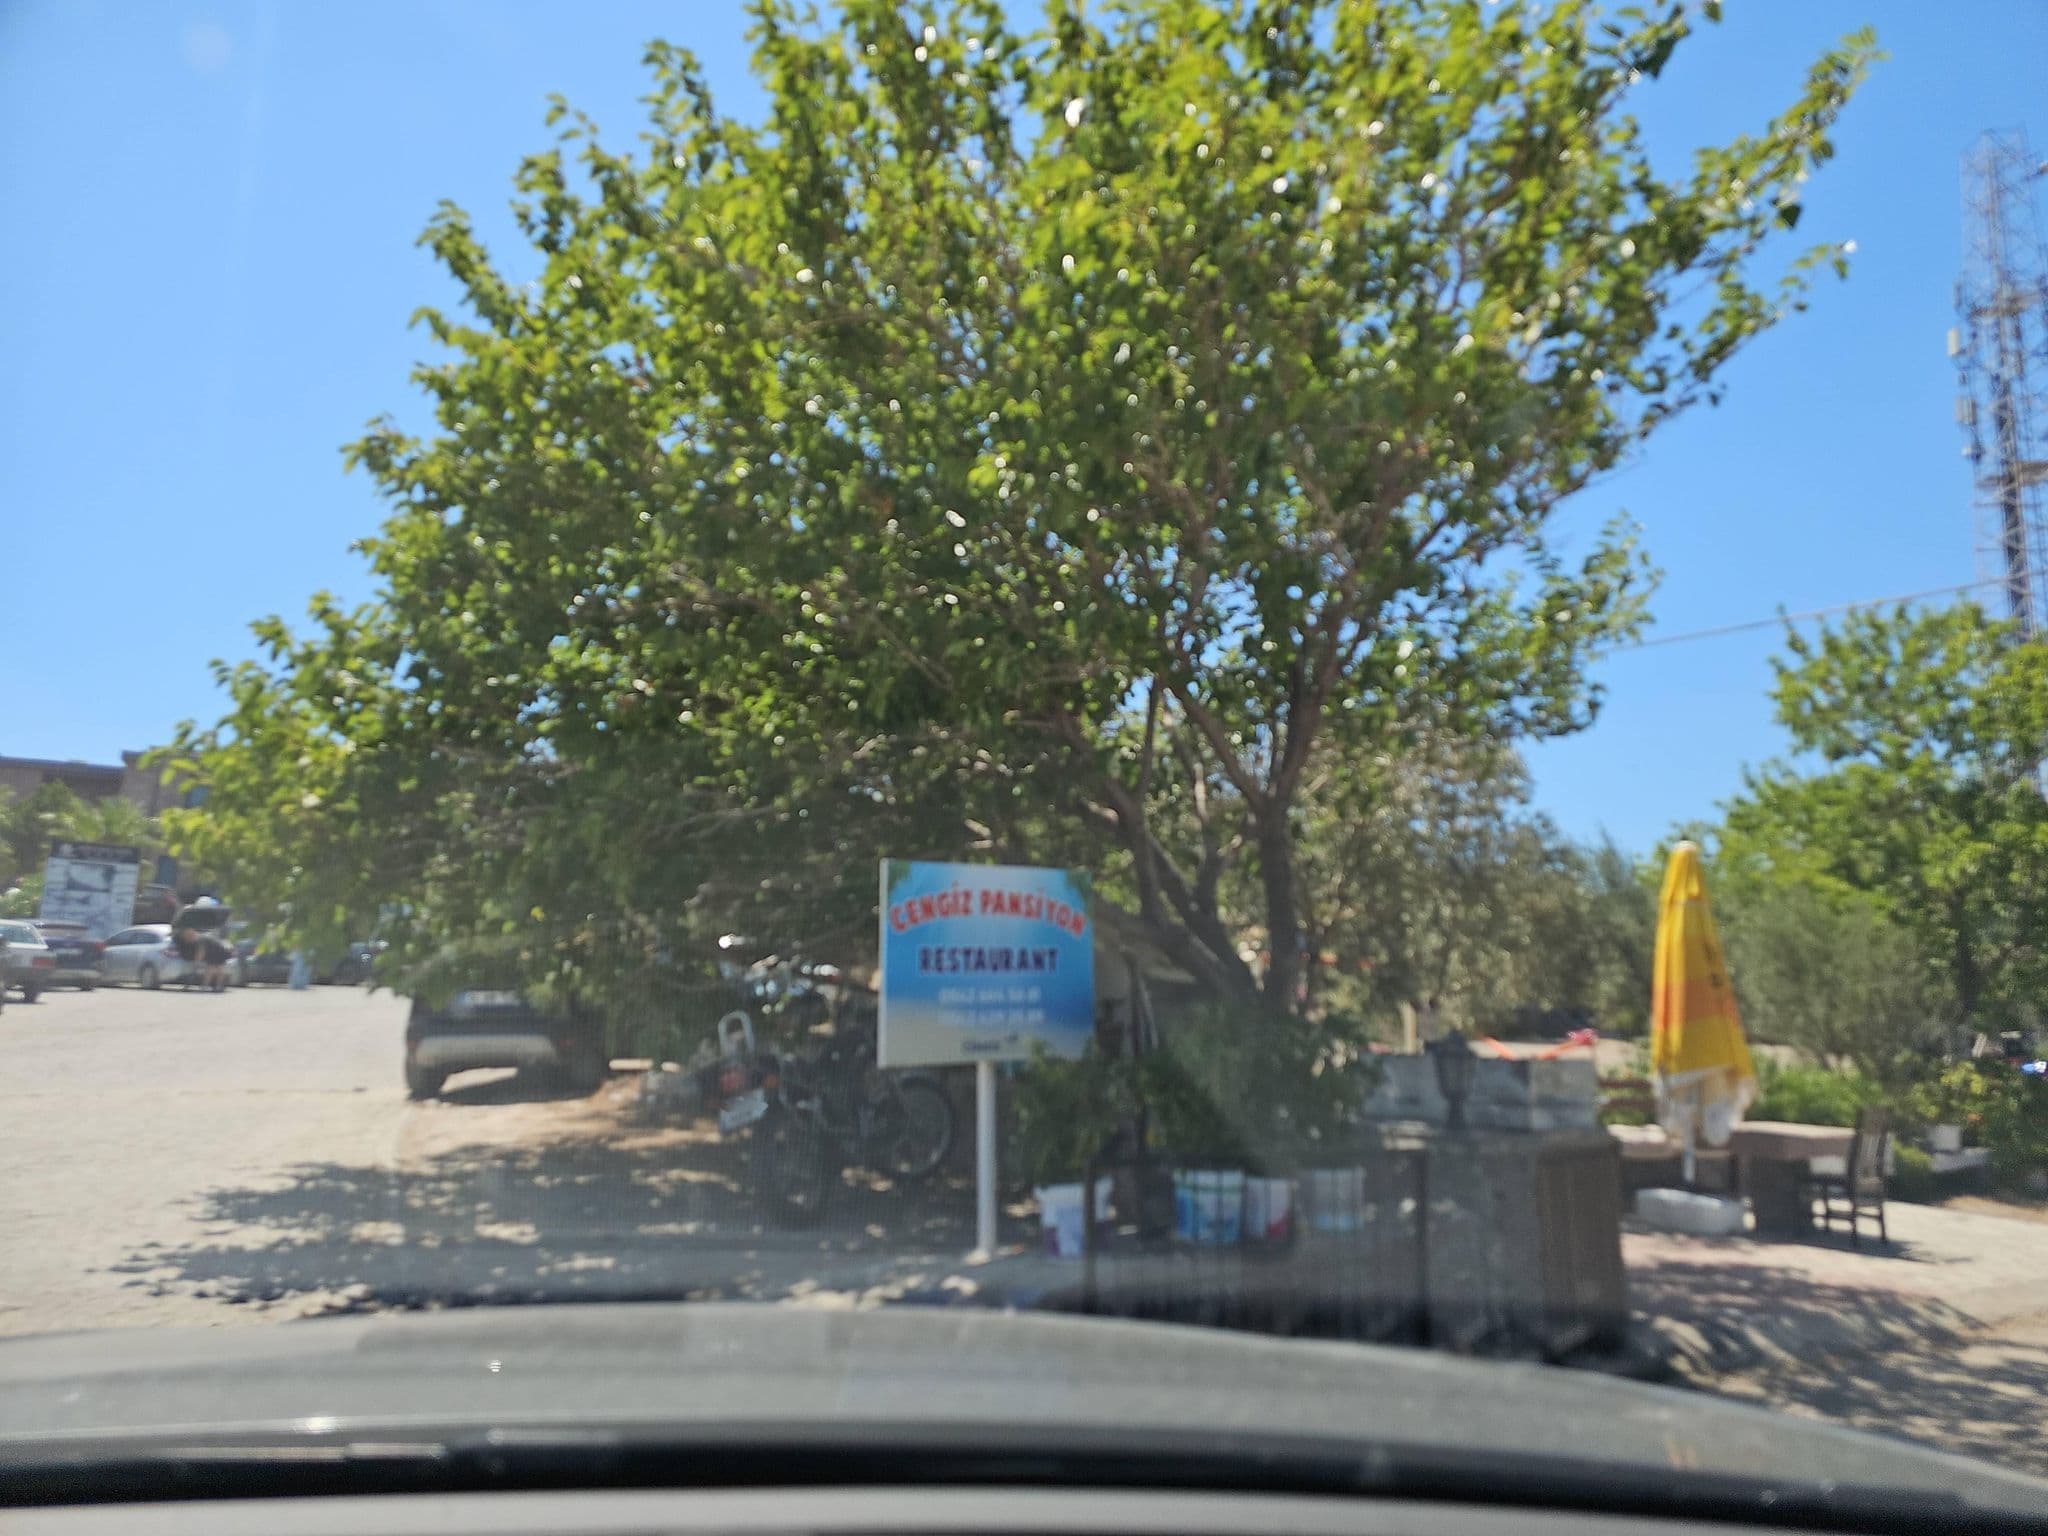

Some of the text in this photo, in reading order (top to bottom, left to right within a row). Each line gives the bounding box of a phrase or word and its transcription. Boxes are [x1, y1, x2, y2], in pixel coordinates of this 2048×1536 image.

[891, 882, 1086, 936] CENGİZ PANSİYON
[920, 947, 1058, 973] RESTAURANT
